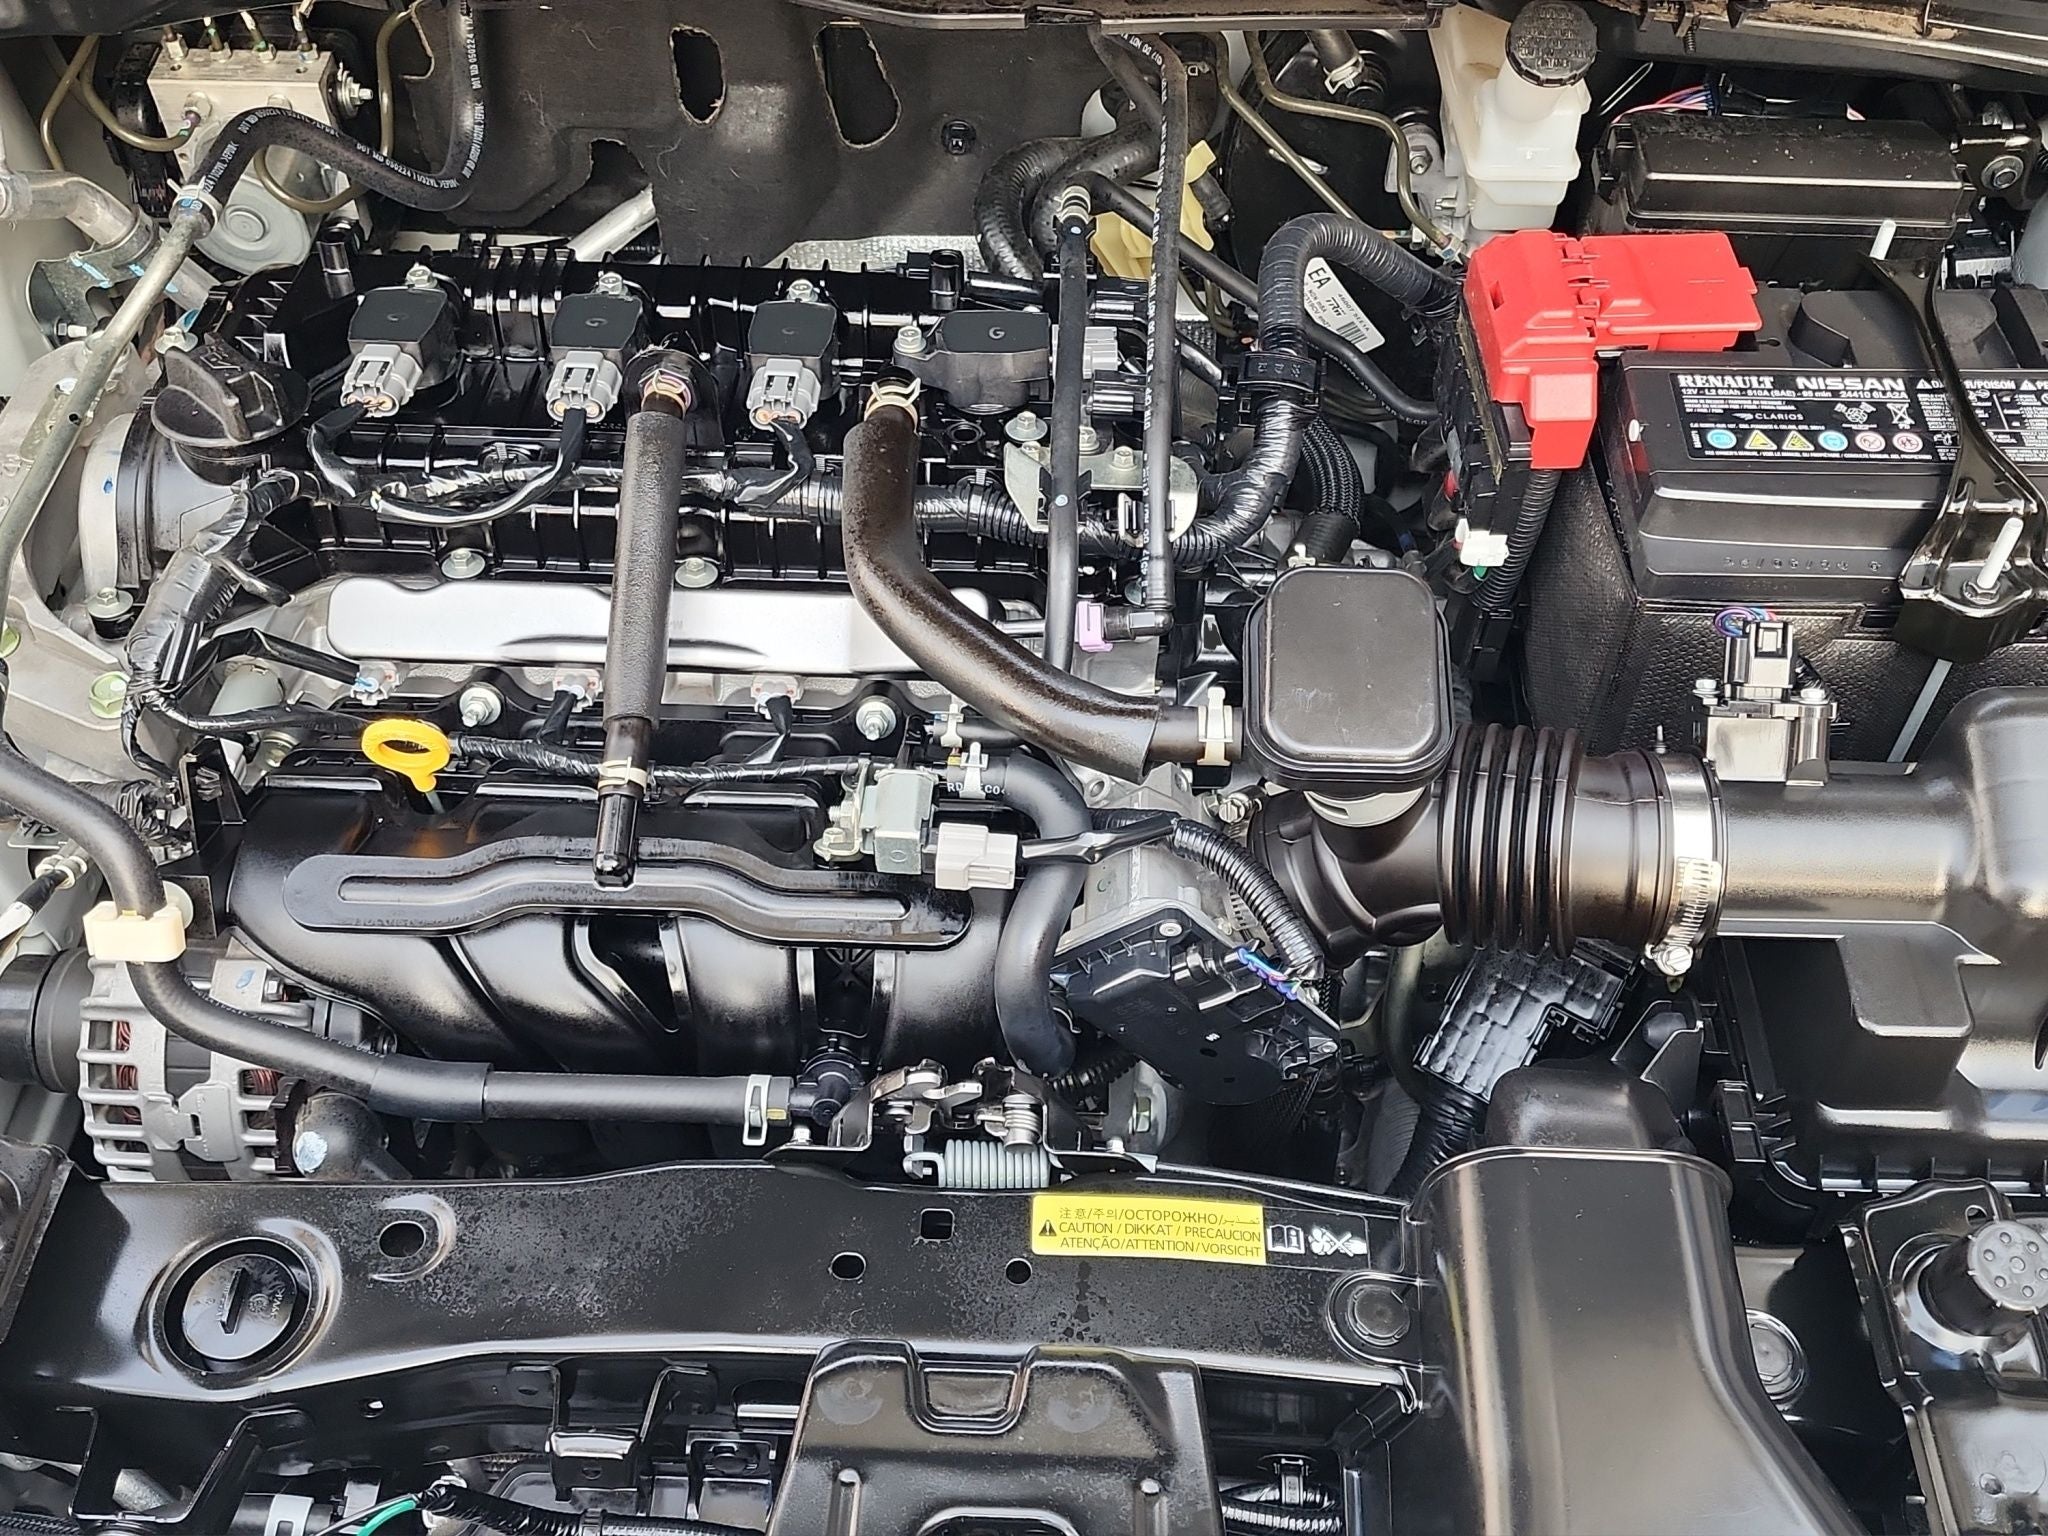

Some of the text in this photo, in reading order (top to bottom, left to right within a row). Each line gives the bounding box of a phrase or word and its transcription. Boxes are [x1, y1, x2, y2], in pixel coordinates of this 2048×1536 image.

[1308, 267, 1331, 289] EA
[988, 326, 1006, 340] G
[1677, 374, 1774, 389] RENAULT
[1795, 376, 1906, 391] NISSAN
[1681, 388, 1698, 396] 12V
[1754, 412, 1804, 421] CLARIOS
[1059, 1221, 1113, 1235] CAUTION
[1184, 1226, 1261, 1243] PRECAUCION
